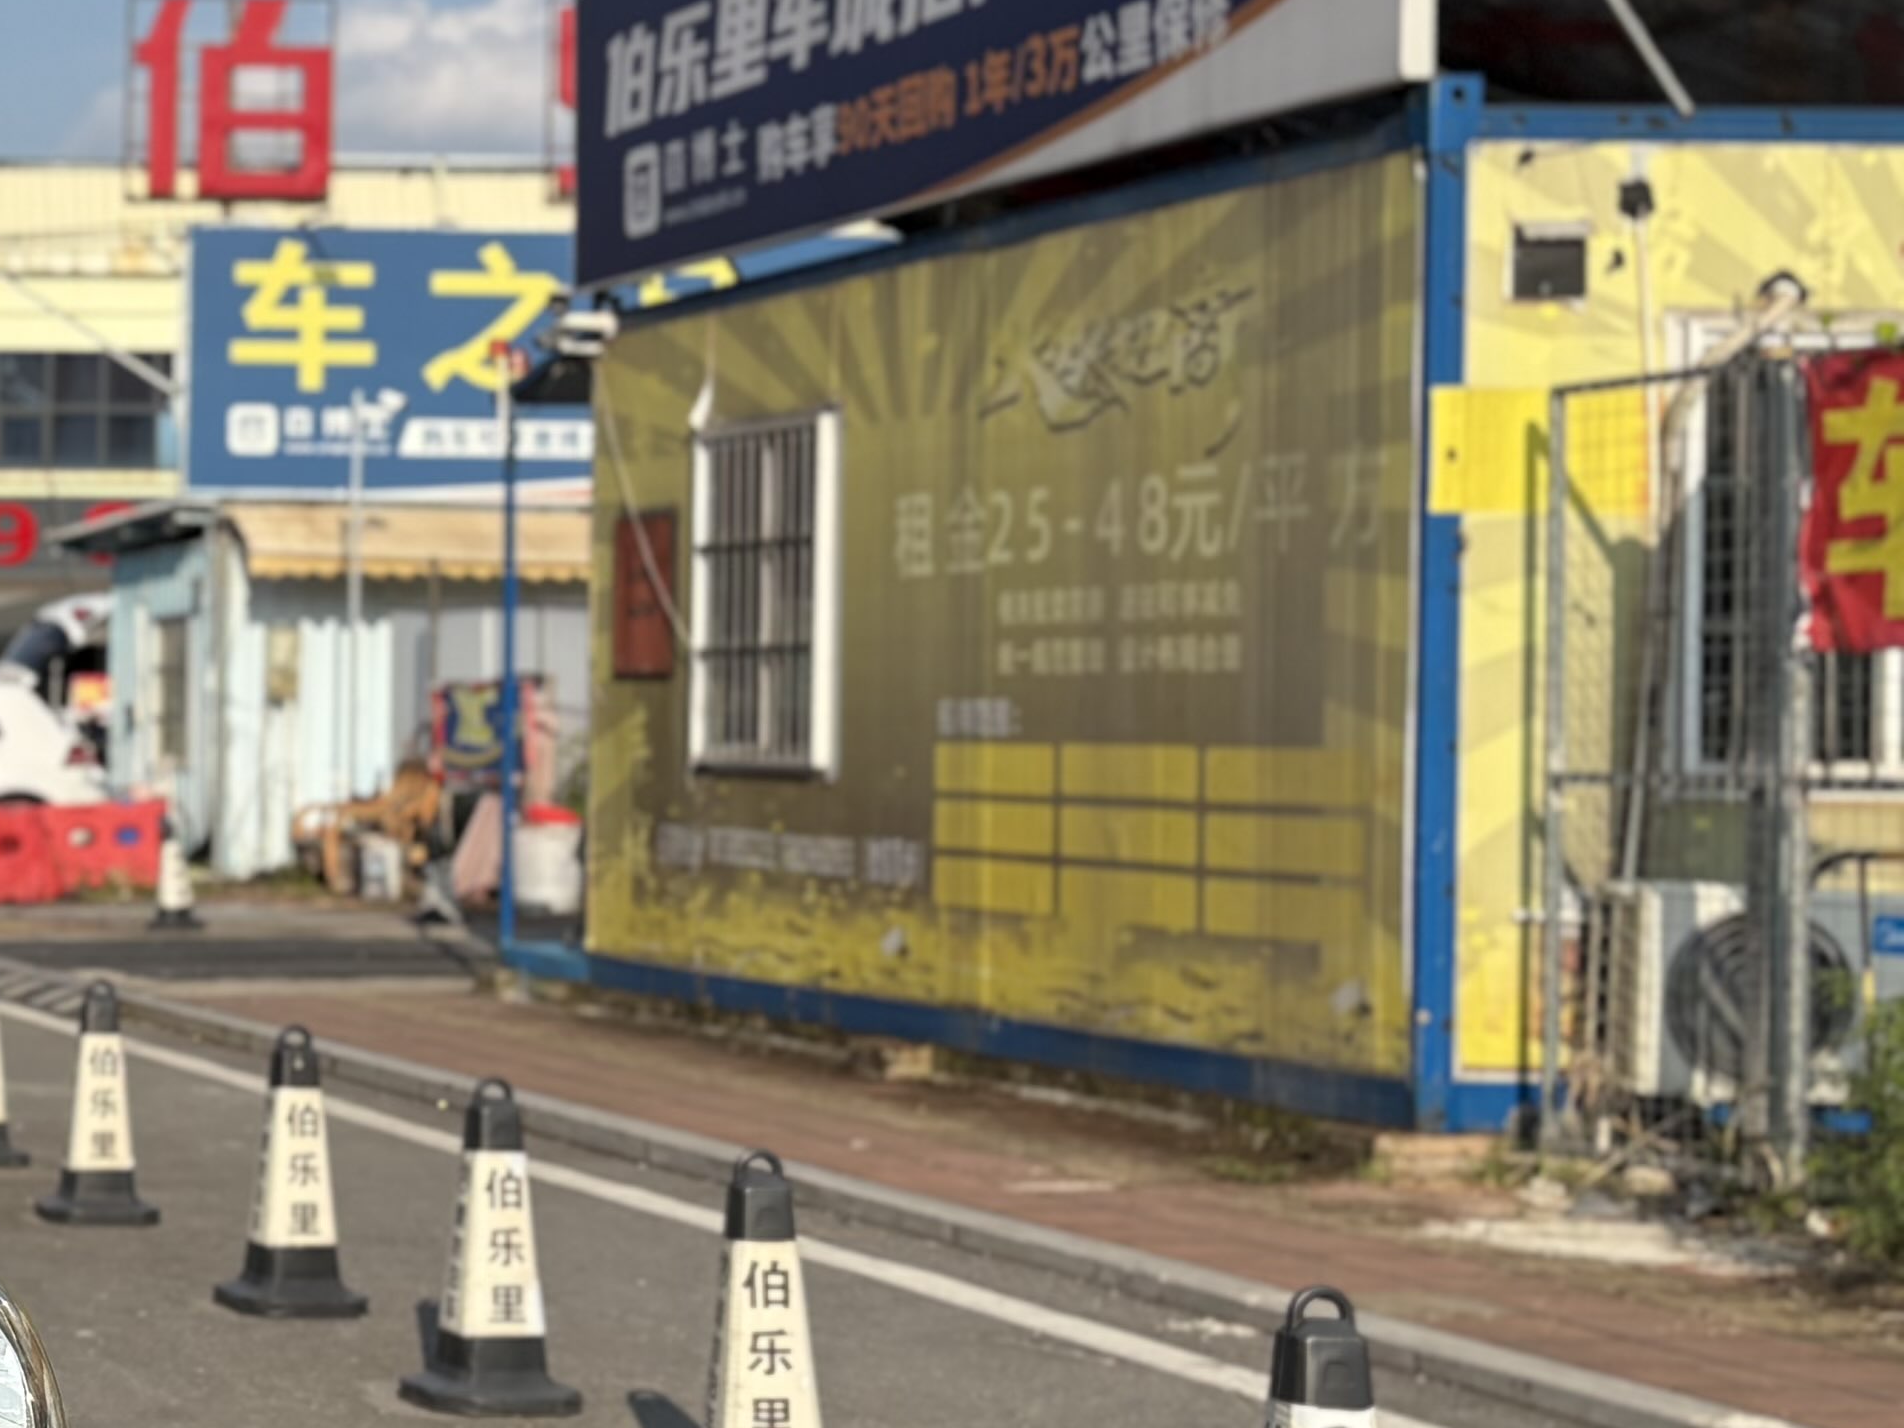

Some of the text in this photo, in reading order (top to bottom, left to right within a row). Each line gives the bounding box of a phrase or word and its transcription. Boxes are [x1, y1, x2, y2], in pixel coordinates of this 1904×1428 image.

[286, 1103, 321, 1237] 伯乐里
[485, 1167, 527, 1324] 伯乐里
